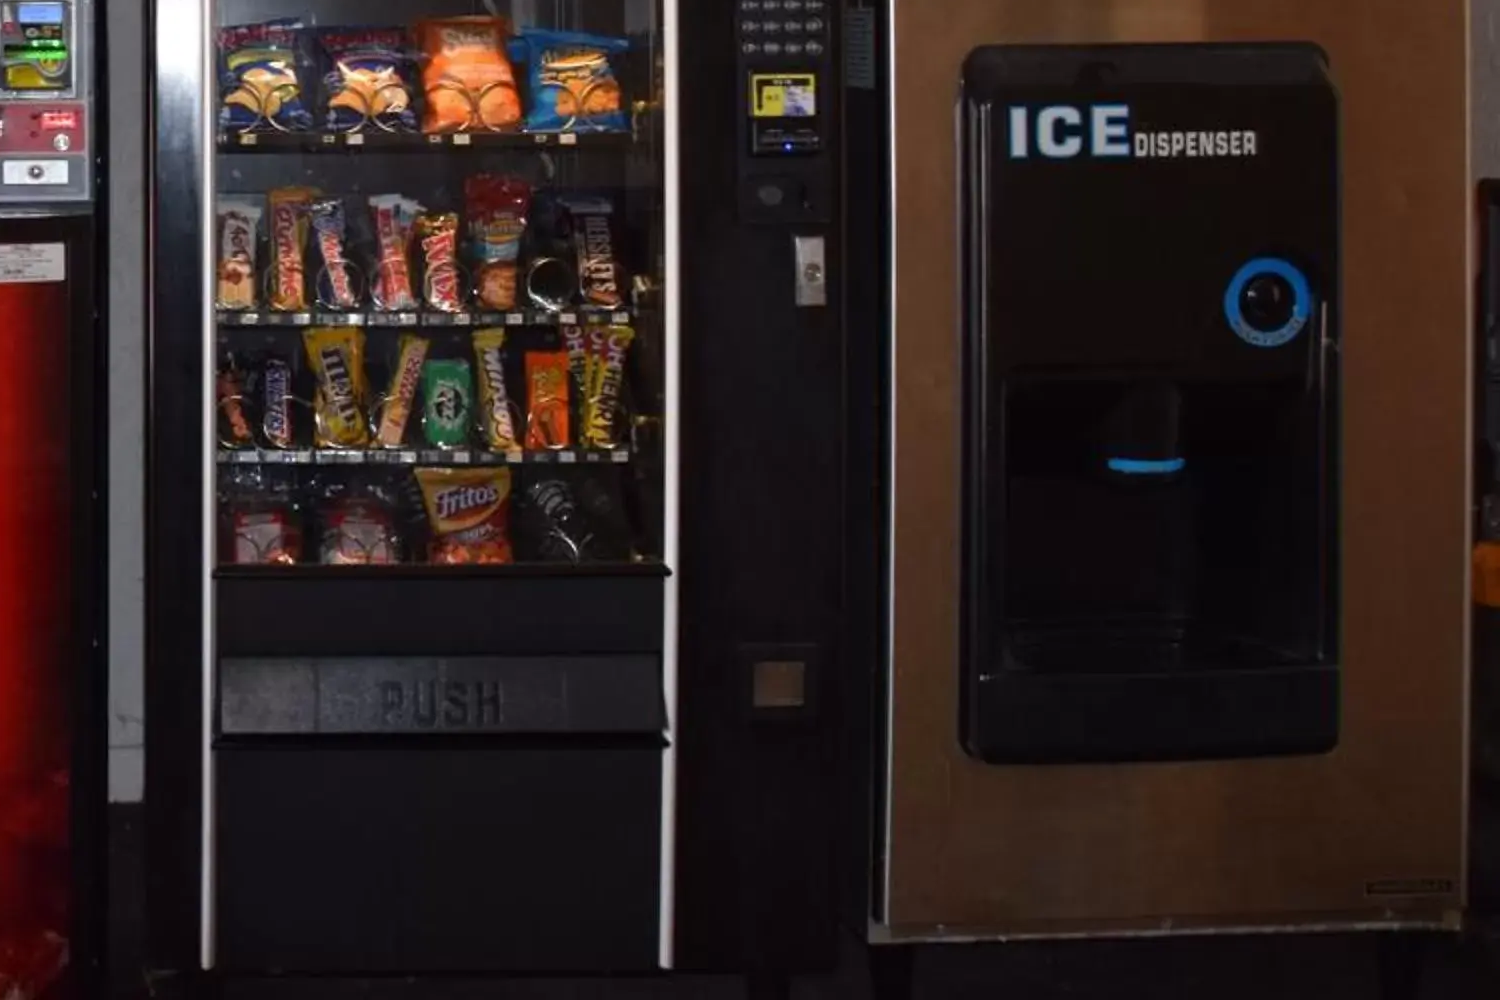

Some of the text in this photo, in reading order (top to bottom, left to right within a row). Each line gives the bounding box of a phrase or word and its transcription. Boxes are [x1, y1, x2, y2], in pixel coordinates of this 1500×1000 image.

[1009, 103, 1130, 158] ICE
[1134, 130, 1257, 158] DISPENSER
[437, 481, 500, 518] Fritos
[381, 678, 503, 727] PUSH
